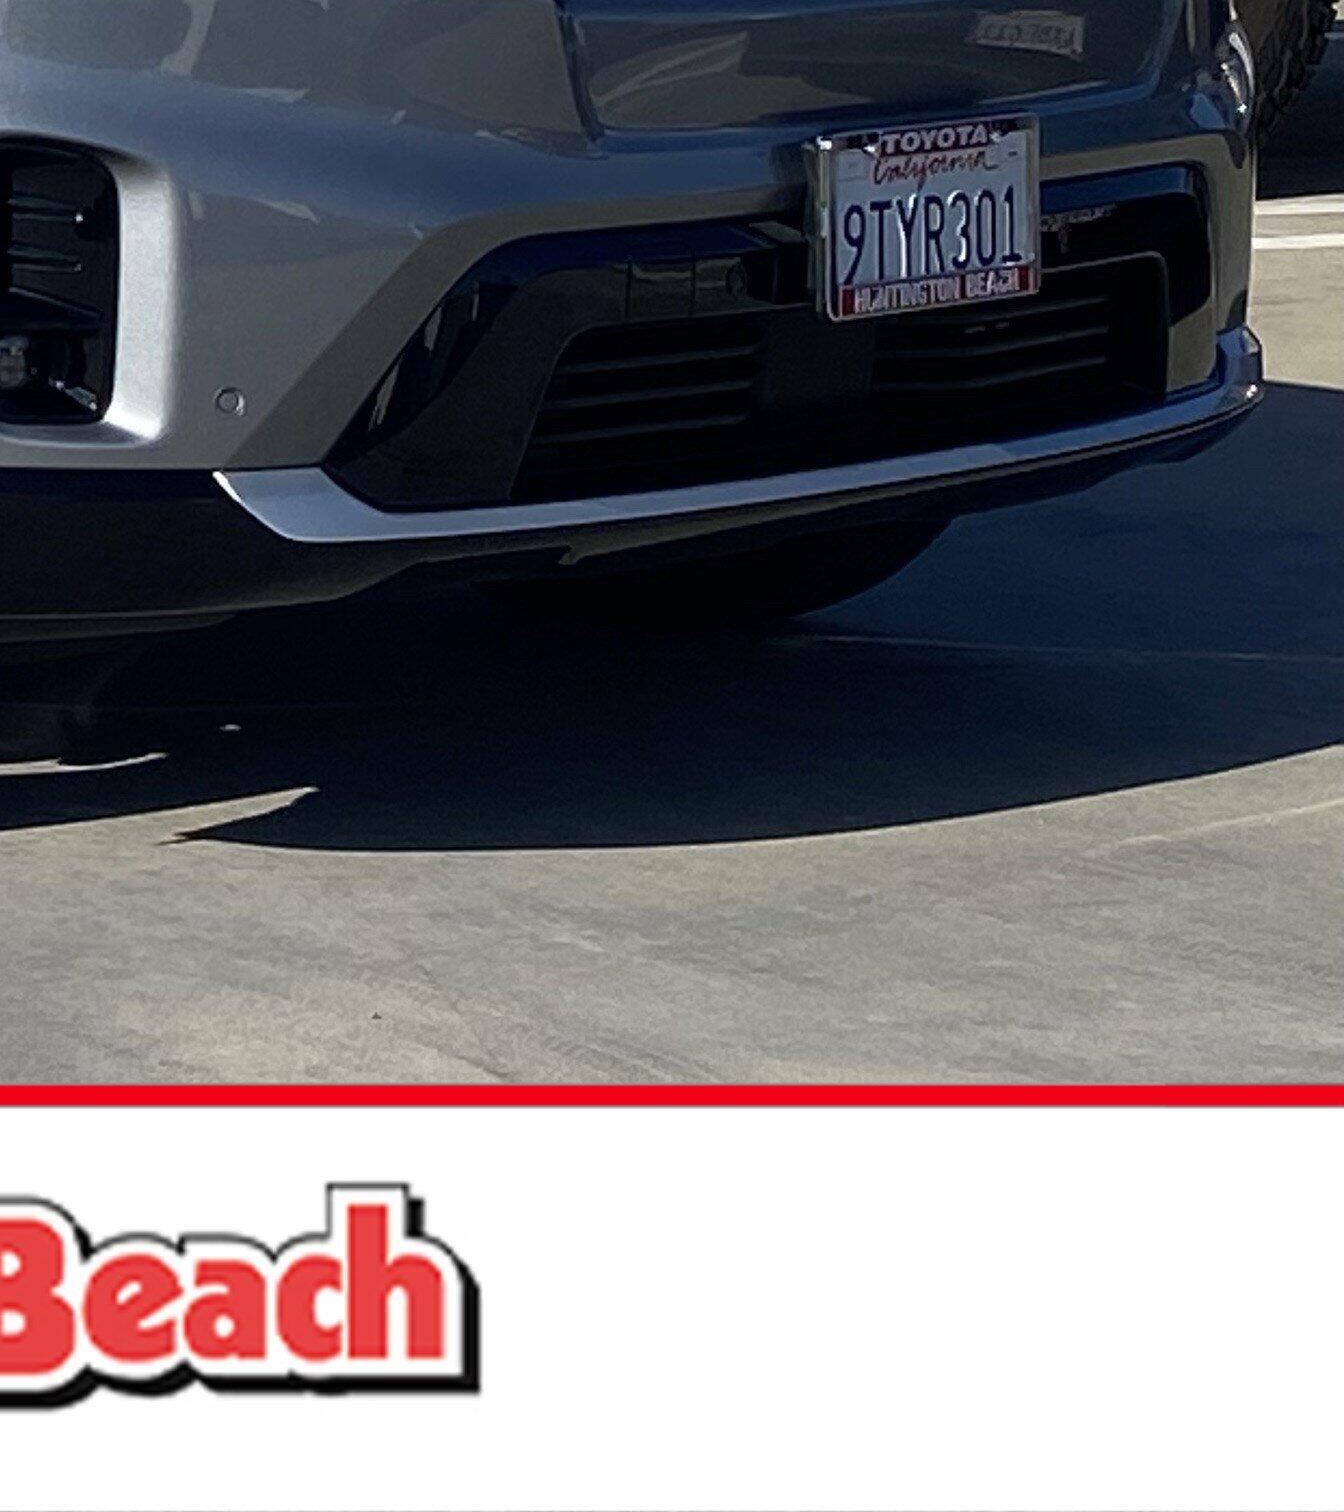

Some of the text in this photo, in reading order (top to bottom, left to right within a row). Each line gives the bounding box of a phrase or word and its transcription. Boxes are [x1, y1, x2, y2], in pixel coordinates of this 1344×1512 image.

[880, 125, 988, 155] TOYOTA
[872, 149, 999, 190] California
[843, 185, 1023, 286] 9TYR301
